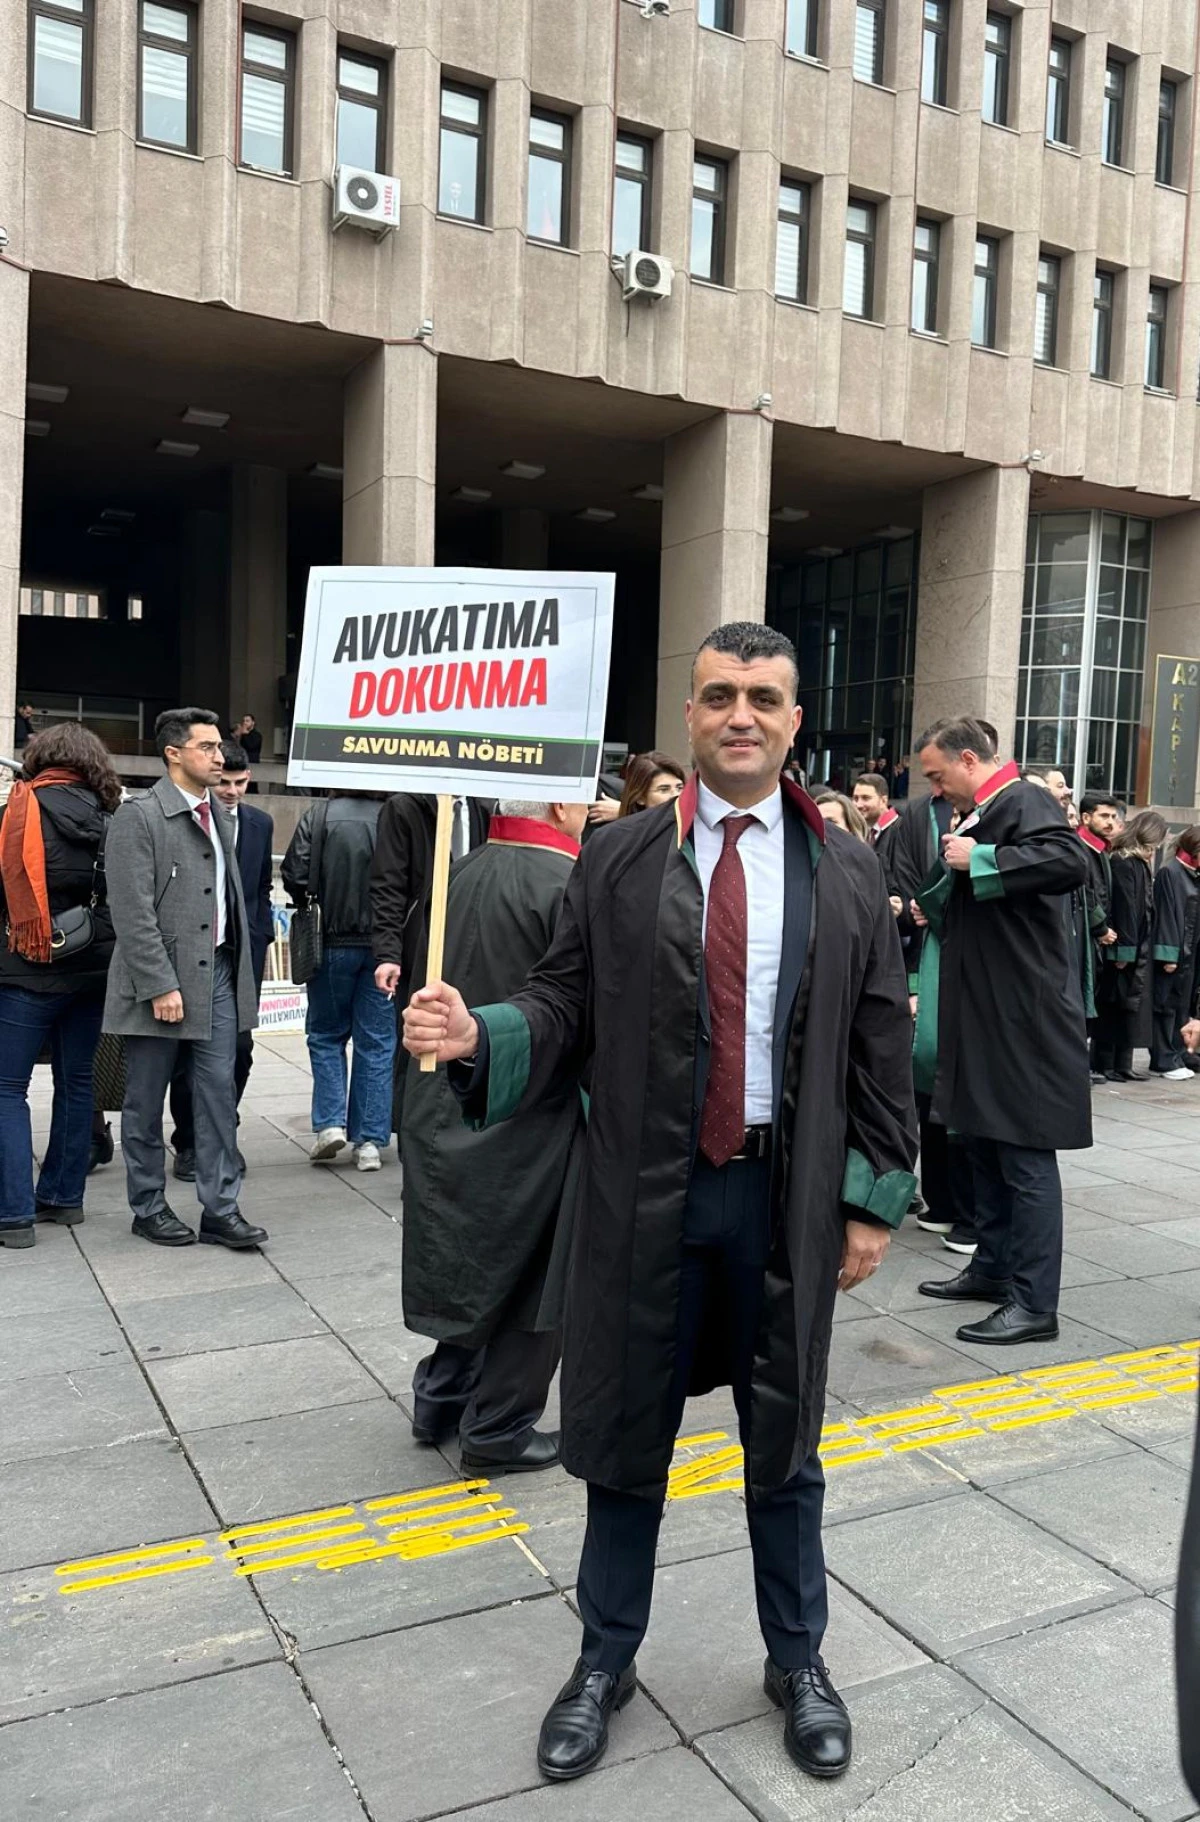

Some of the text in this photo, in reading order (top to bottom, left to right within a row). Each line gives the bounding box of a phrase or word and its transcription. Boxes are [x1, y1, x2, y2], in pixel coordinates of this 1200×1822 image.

[332, 598, 559, 664] AVUKATIMA
[348, 658, 548, 719] DOKUNMA
[342, 736, 544, 765] SAVUNMA NÖBETİ
[261, 1008, 306, 1025] AVUKATIM
[262, 996, 301, 1013] DOKUNM
